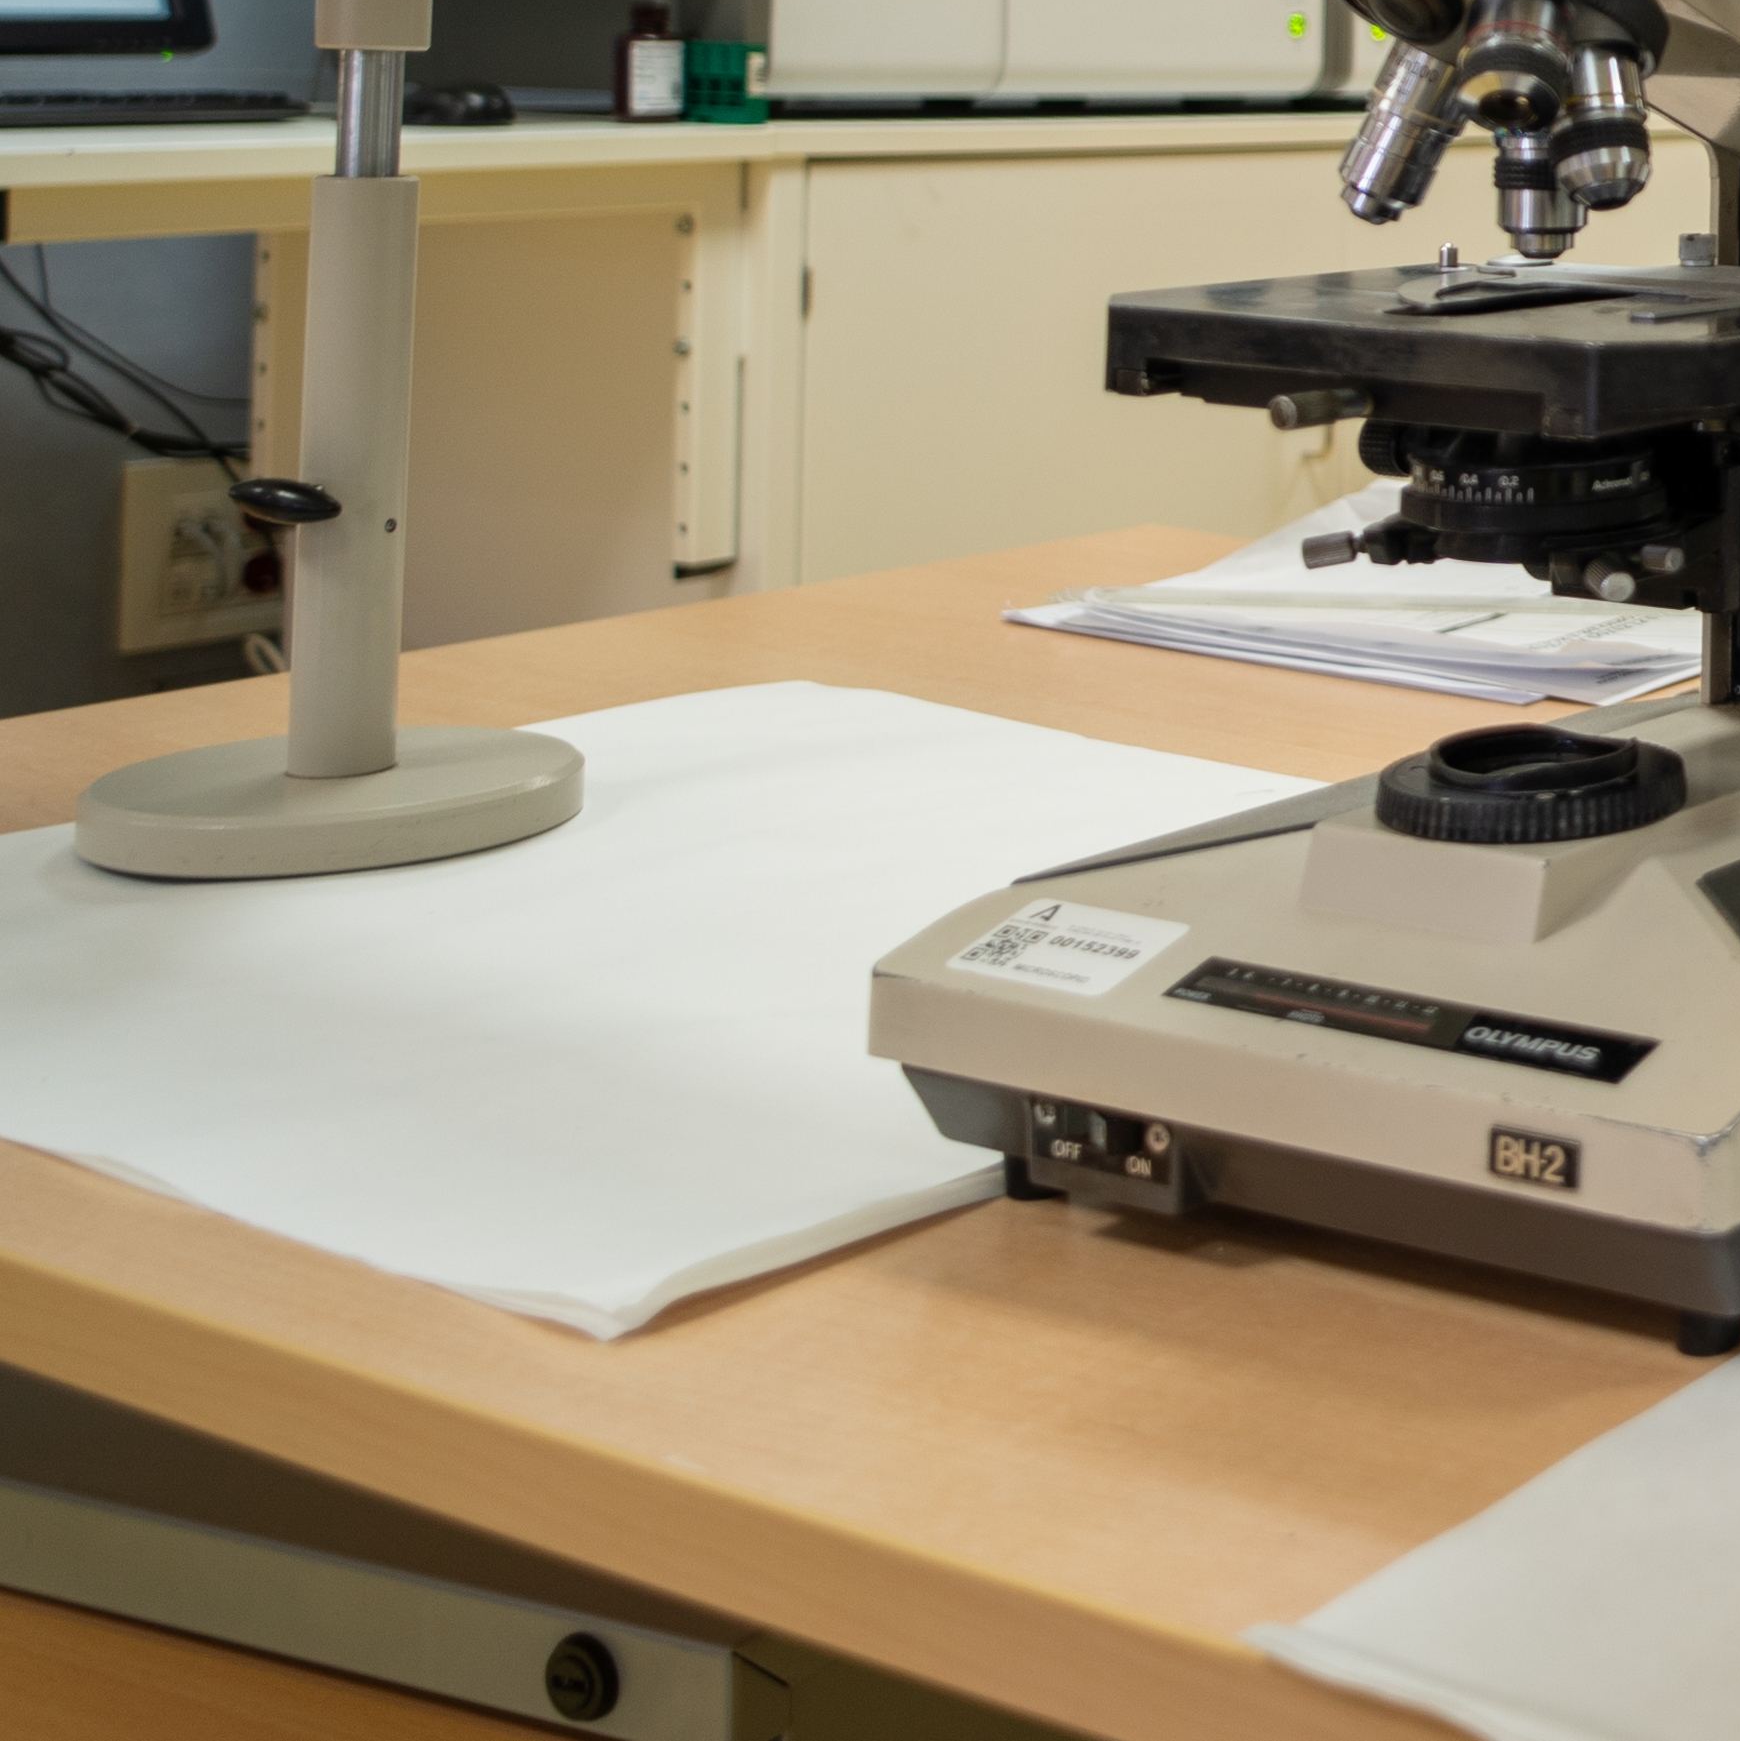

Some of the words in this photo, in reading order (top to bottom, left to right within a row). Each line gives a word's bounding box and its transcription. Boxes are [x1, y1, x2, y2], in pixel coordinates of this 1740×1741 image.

[1048, 934, 1143, 961] 00152399
[1463, 1024, 1603, 1063] OLYMPUS
[1051, 1138, 1083, 1160] OFF
[1124, 1154, 1153, 1178] ON
